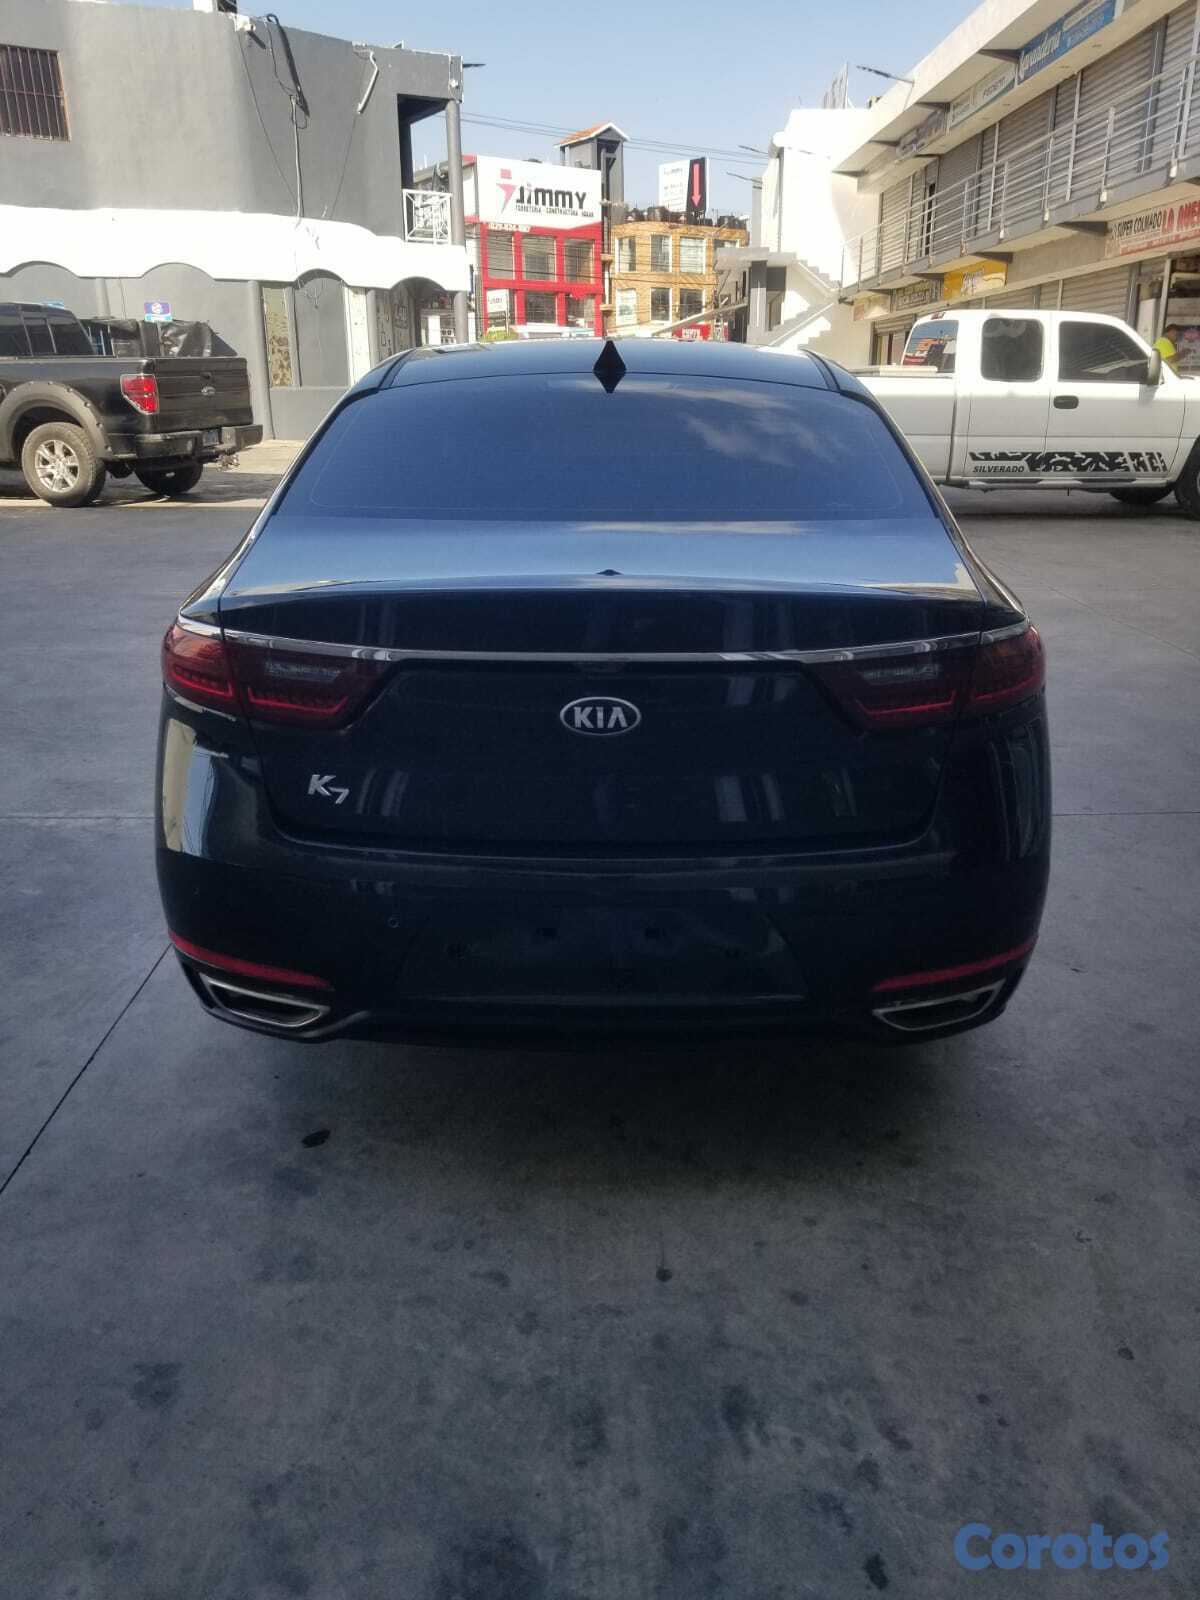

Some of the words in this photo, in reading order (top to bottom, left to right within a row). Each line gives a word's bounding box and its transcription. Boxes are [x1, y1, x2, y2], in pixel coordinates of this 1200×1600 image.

[1117, 219, 1133, 237] SUPER
[1132, 210, 1162, 235] COLMADO
[973, 465, 1025, 473] SILVERADO
[573, 706, 628, 729] KIA
[308, 774, 350, 804] K7
